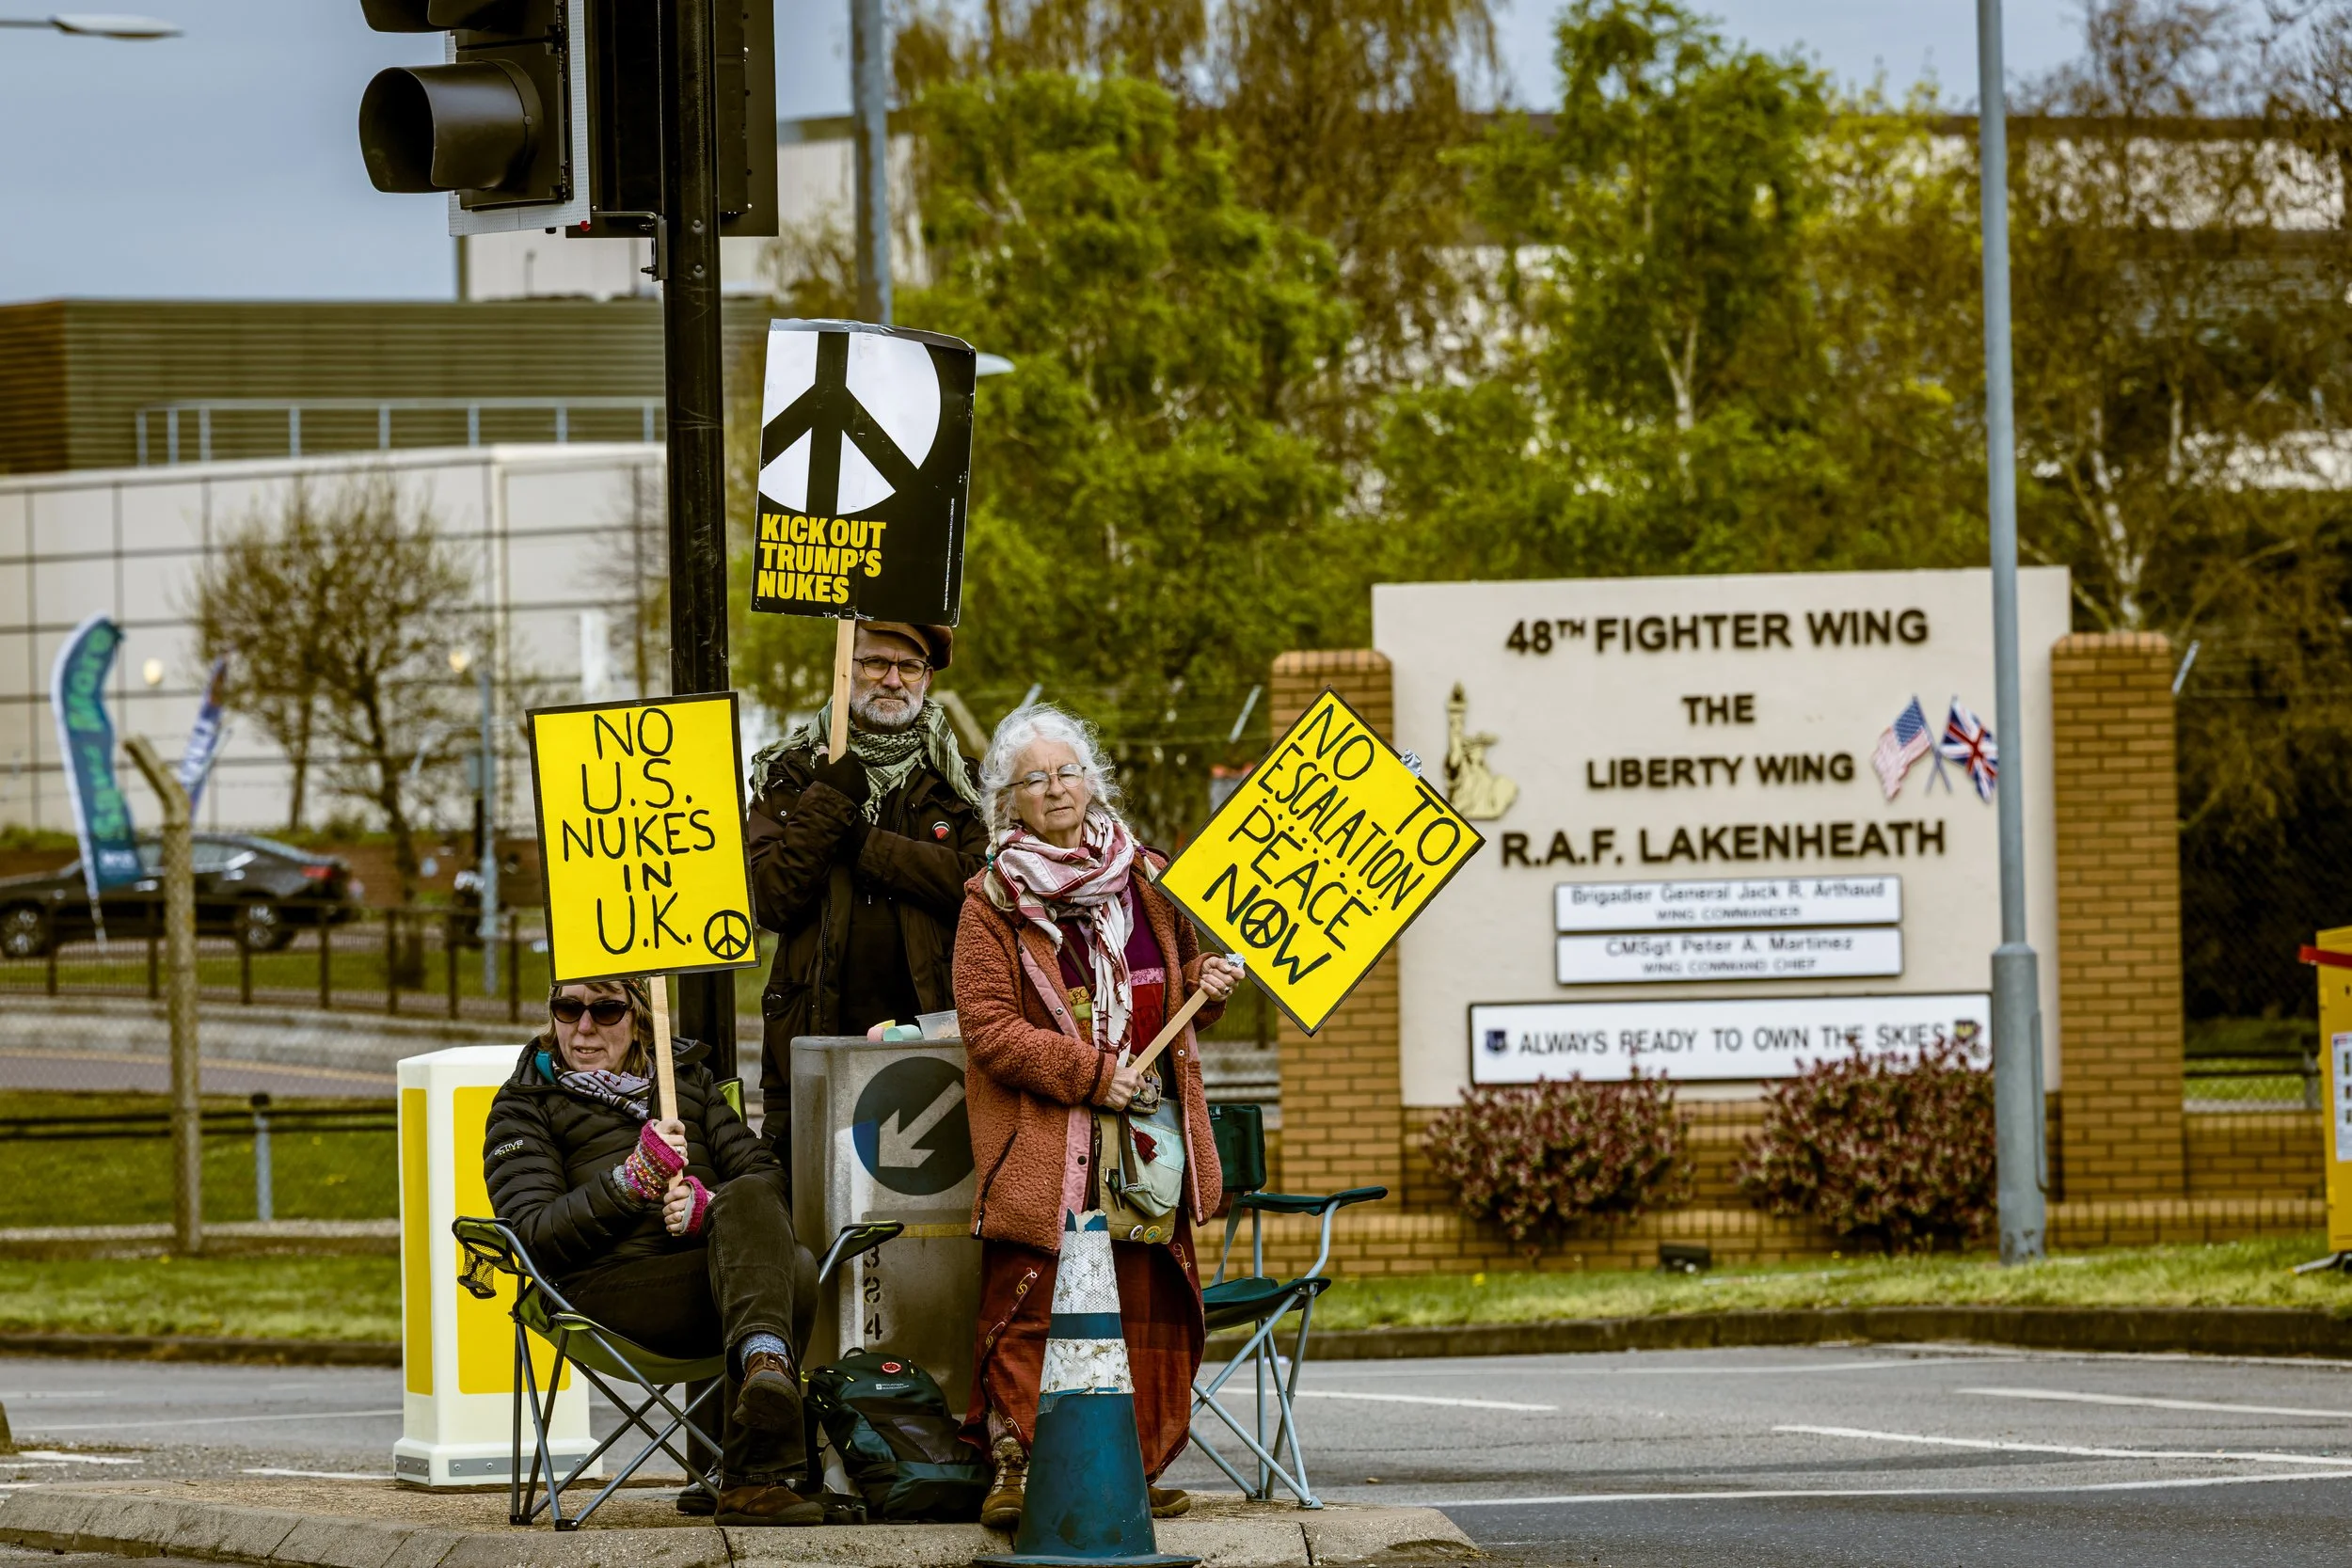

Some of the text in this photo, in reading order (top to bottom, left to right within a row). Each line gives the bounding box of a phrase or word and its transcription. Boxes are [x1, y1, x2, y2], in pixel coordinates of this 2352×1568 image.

[761, 513, 886, 548] KICK OUT
[759, 542, 882, 578] TRUMP'S
[757, 570, 849, 604] NUKES
[1506, 609, 1928, 656] 48TH FIGHTER WING
[1681, 693, 1756, 724] THE
[594, 707, 674, 760] NO
[581, 757, 692, 815] U.S.
[1298, 704, 1460, 866] NO TO
[1587, 752, 1855, 789] LIBERTY WING
[563, 809, 716, 862] NUKES
[1257, 742, 1425, 911] ESCALATION
[1502, 820, 1946, 867] R.A.F. LAKENHEATH
[624, 861, 673, 893] IN
[1228, 804, 1372, 951] PEACE
[1572, 886, 1651, 908] Brigadier
[1661, 883, 1730, 903] General
[1740, 882, 1777, 900] Jack
[596, 892, 692, 955] U.K.
[1656, 909, 1695, 921] WING
[1681, 937, 1731, 953] Peter
[1770, 934, 1852, 951] Martinez
[1518, 1022, 1945, 1054] ALWAYS READY TO OWN THE SKIES
